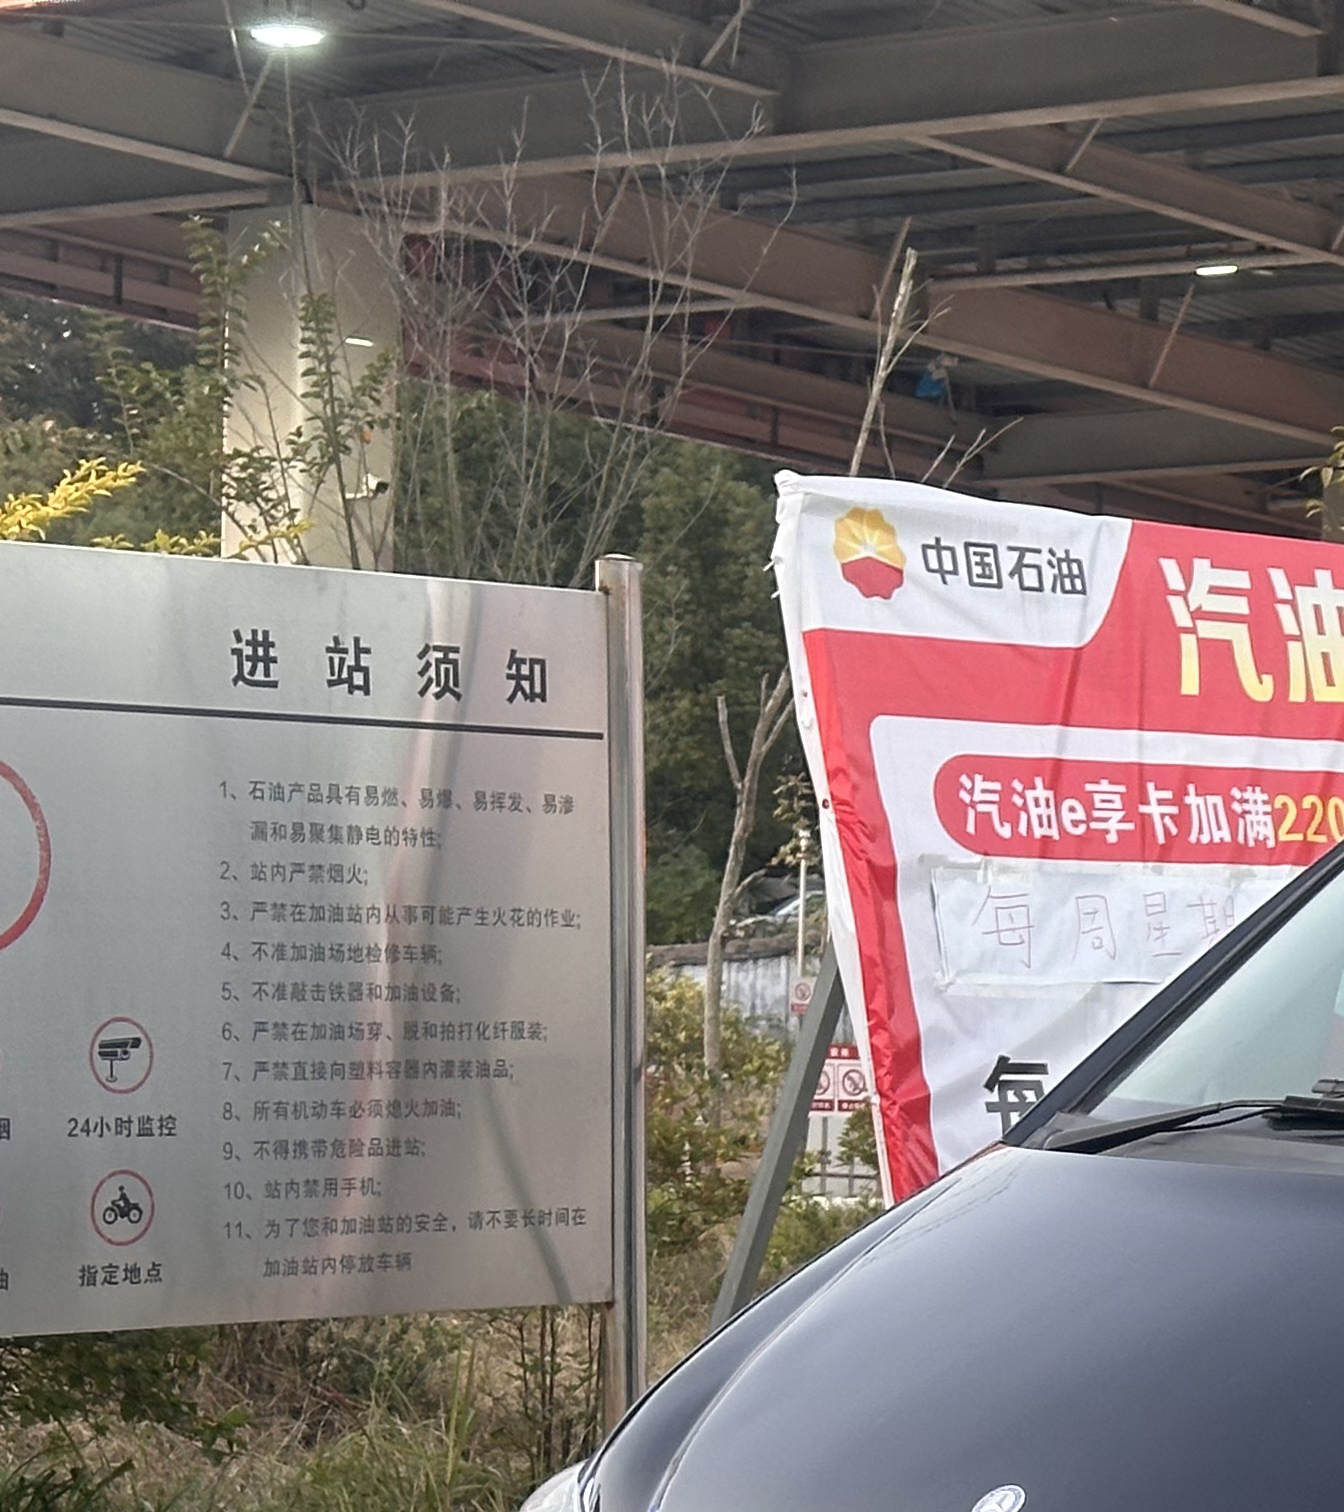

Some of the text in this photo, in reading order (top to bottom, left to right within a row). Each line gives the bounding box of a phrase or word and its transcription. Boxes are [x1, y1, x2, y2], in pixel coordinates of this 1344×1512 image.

[920, 536, 1087, 597] 中国石油
[230, 628, 549, 703] 进站须知
[67, 1114, 178, 1138] 24小时监控
[78, 1261, 163, 1288] 指定地点
[262, 1252, 413, 1278] 加油站内停放车辆
